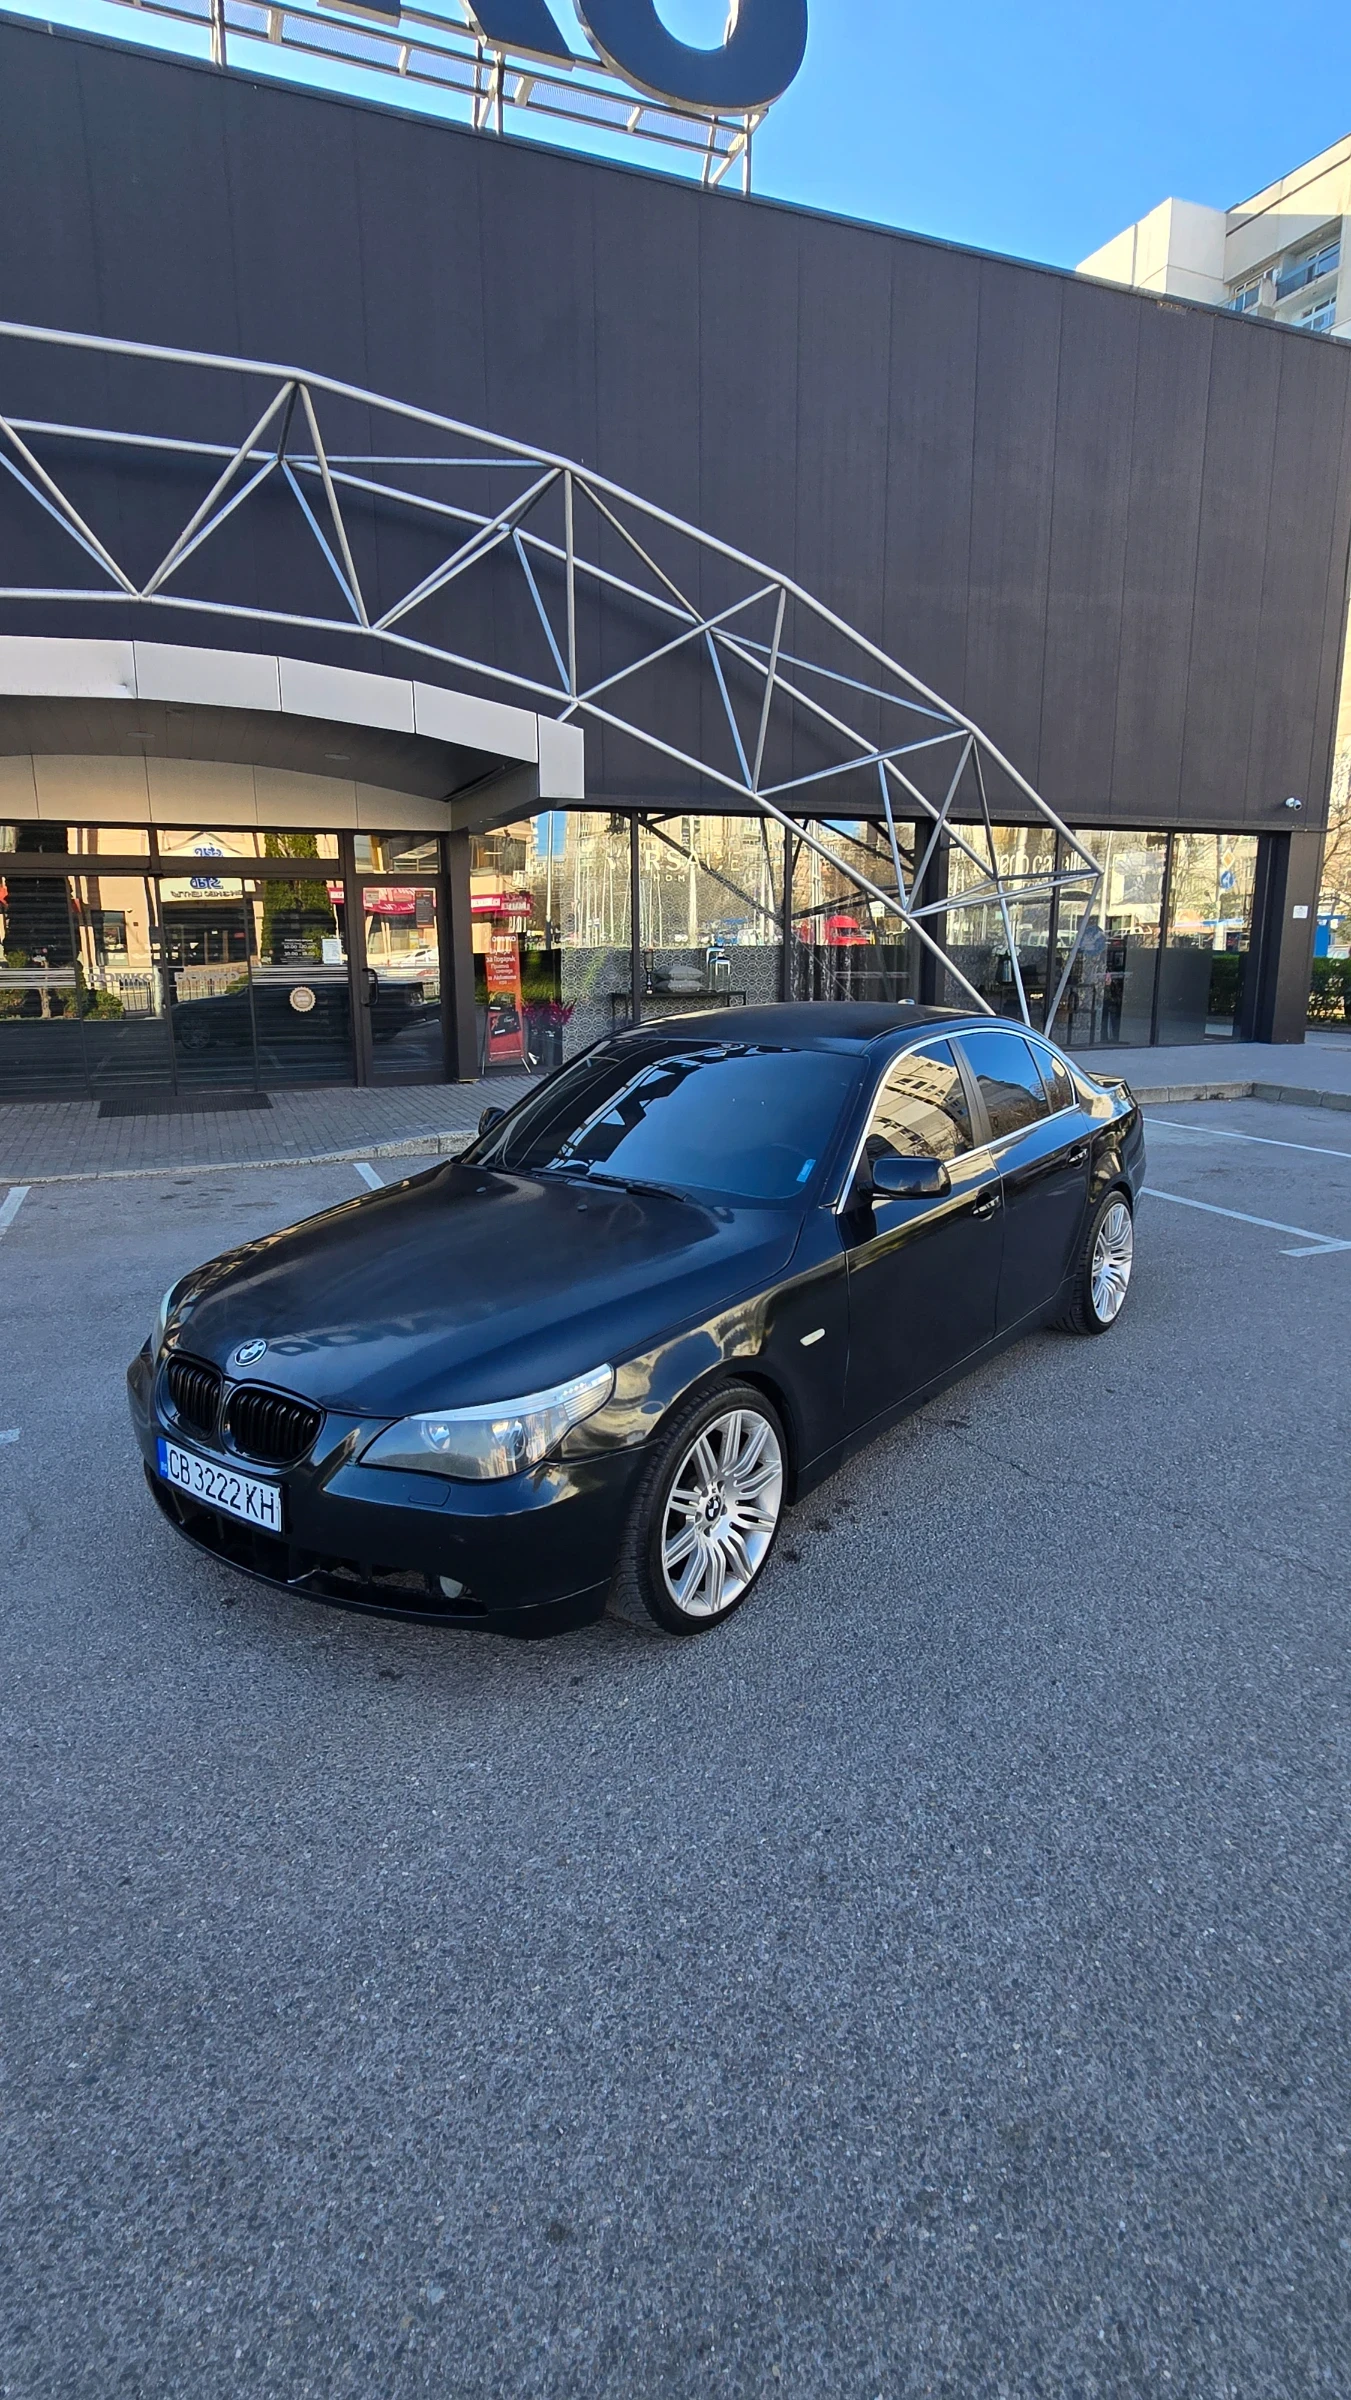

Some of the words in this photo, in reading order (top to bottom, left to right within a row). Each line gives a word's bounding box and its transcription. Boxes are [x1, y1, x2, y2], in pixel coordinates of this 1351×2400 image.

[169, 1449, 191, 1485] CB
[194, 1462, 241, 1511] 3222
[245, 1483, 275, 1524] KH
